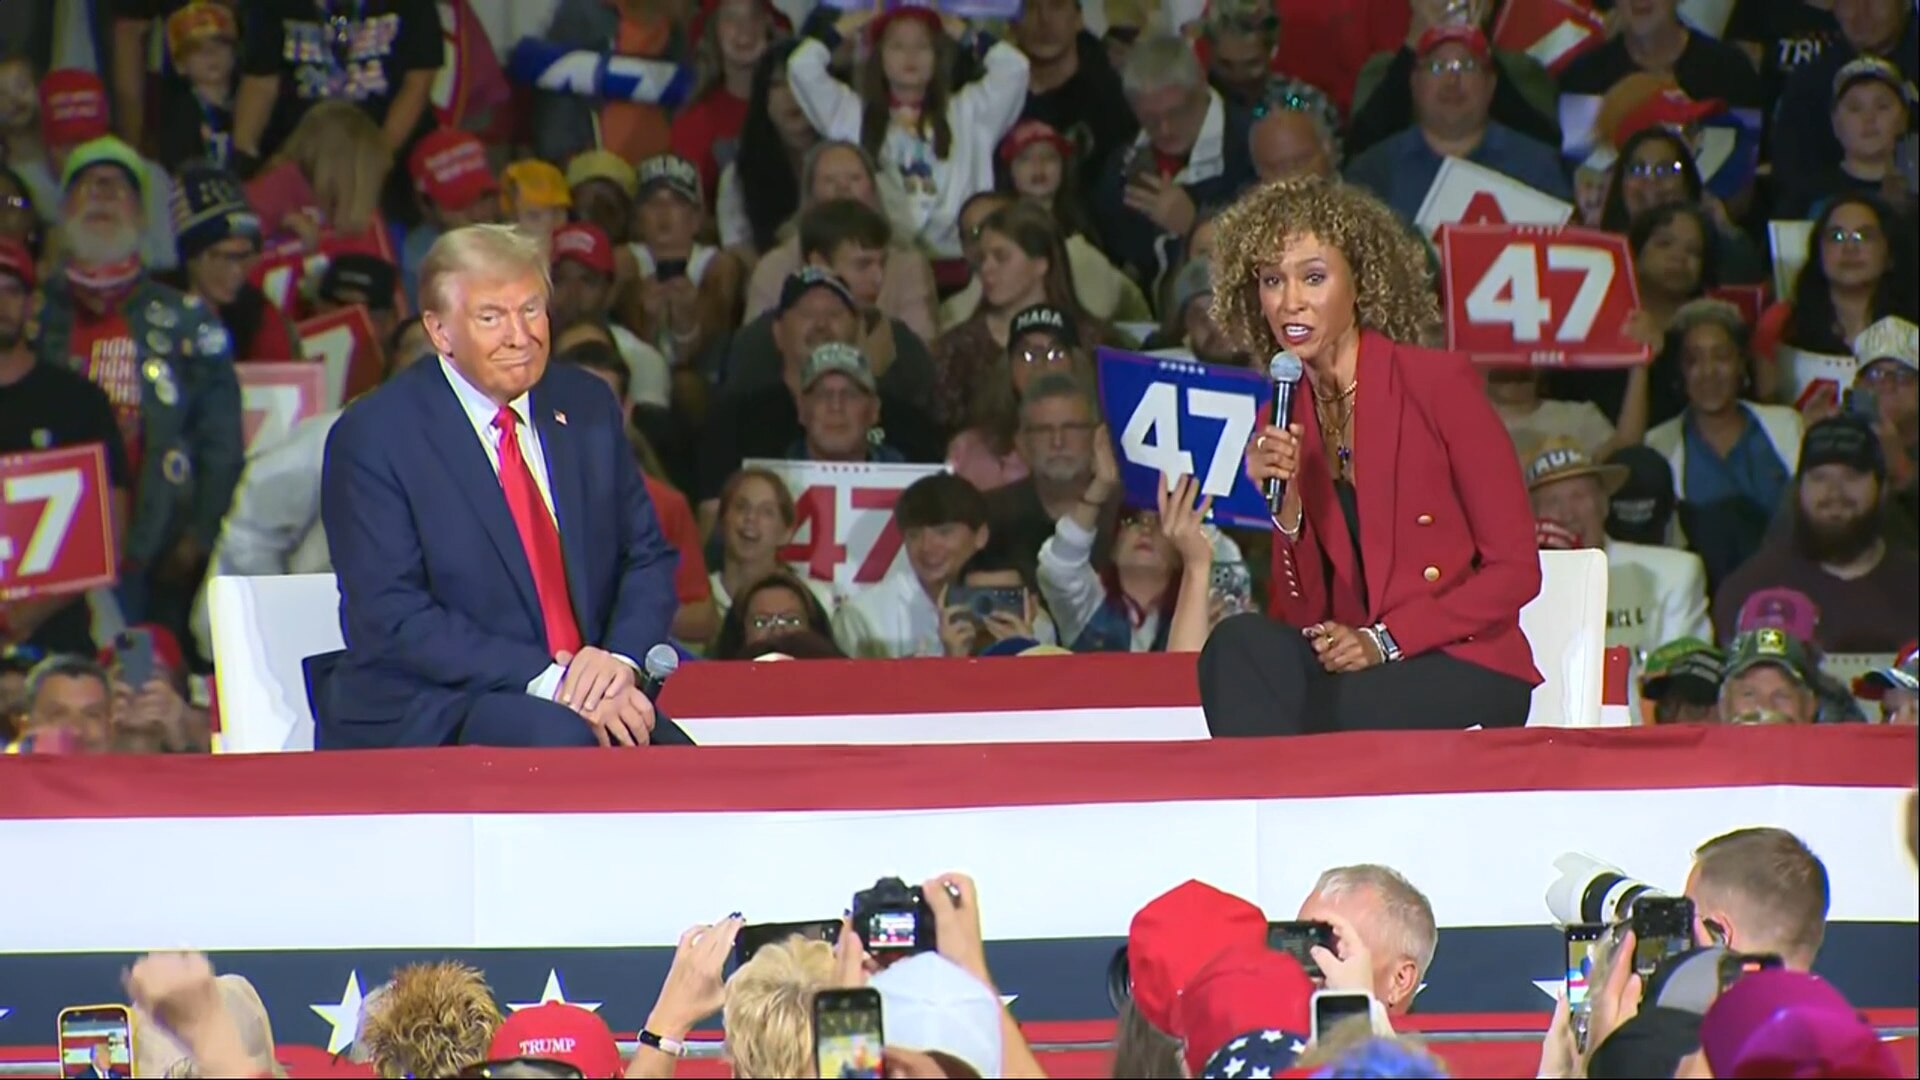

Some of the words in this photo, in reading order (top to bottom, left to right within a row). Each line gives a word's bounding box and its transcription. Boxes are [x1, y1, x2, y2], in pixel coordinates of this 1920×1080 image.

[1465, 243, 1616, 342] 47
[1120, 381, 1257, 498] 47
[775, 485, 907, 583] 47
[519, 1037, 577, 1056] TRUMP
